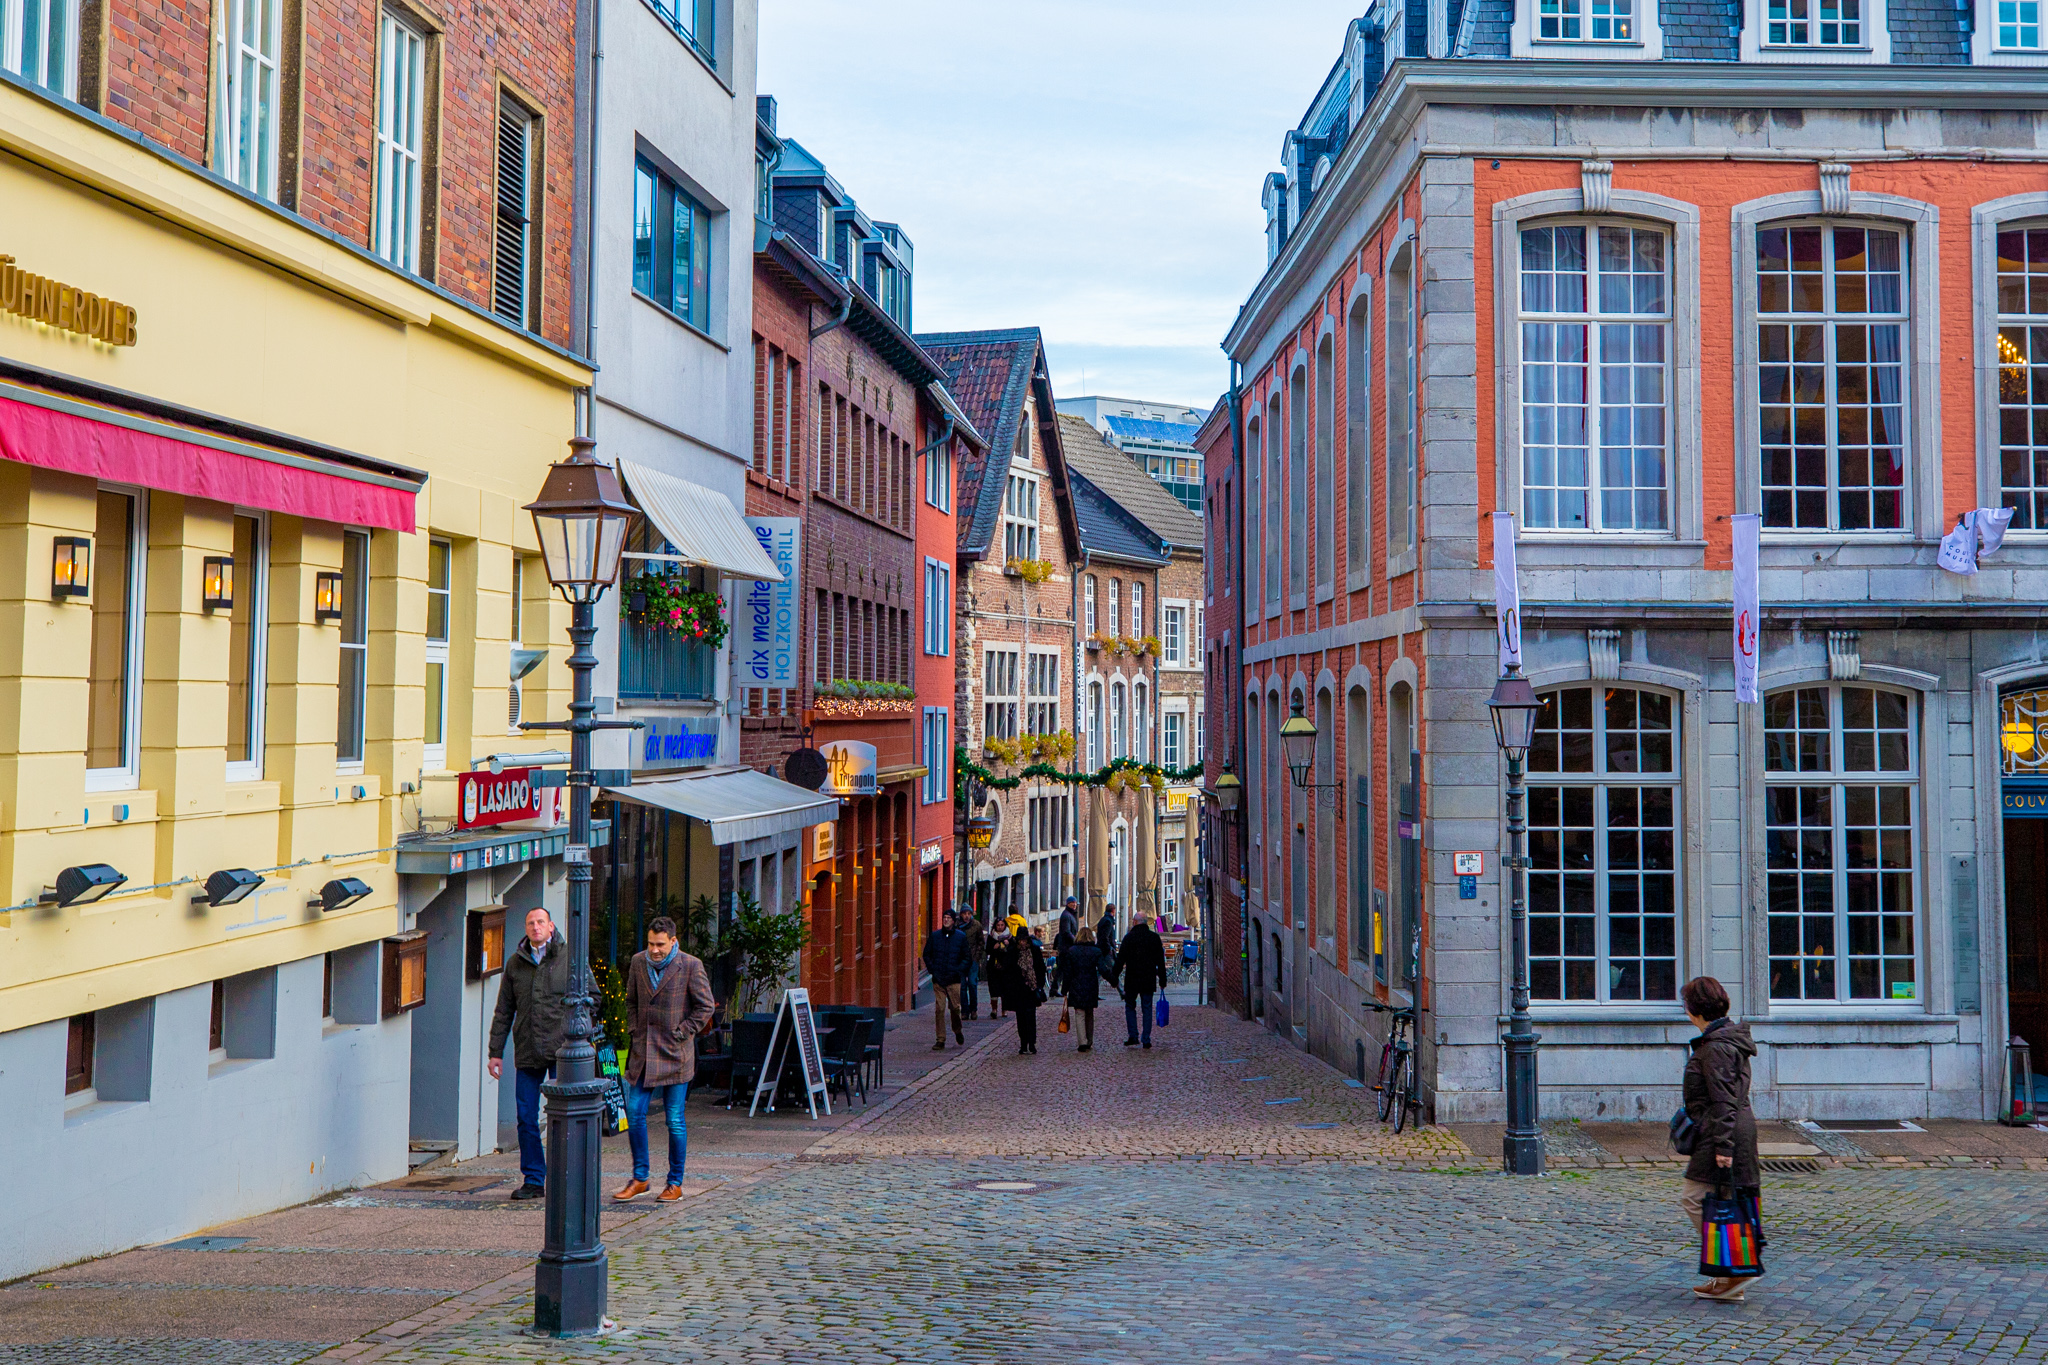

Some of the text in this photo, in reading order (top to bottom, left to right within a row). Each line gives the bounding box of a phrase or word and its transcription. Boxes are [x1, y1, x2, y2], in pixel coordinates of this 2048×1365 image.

[745, 526, 772, 680] aix meditene
[775, 528, 793, 680] HOLZKOHLEGRILL
[645, 724, 661, 761] aix
[826, 744, 848, 787] Al
[479, 779, 529, 814] LASARO
[2004, 795, 2048, 808] COUV
